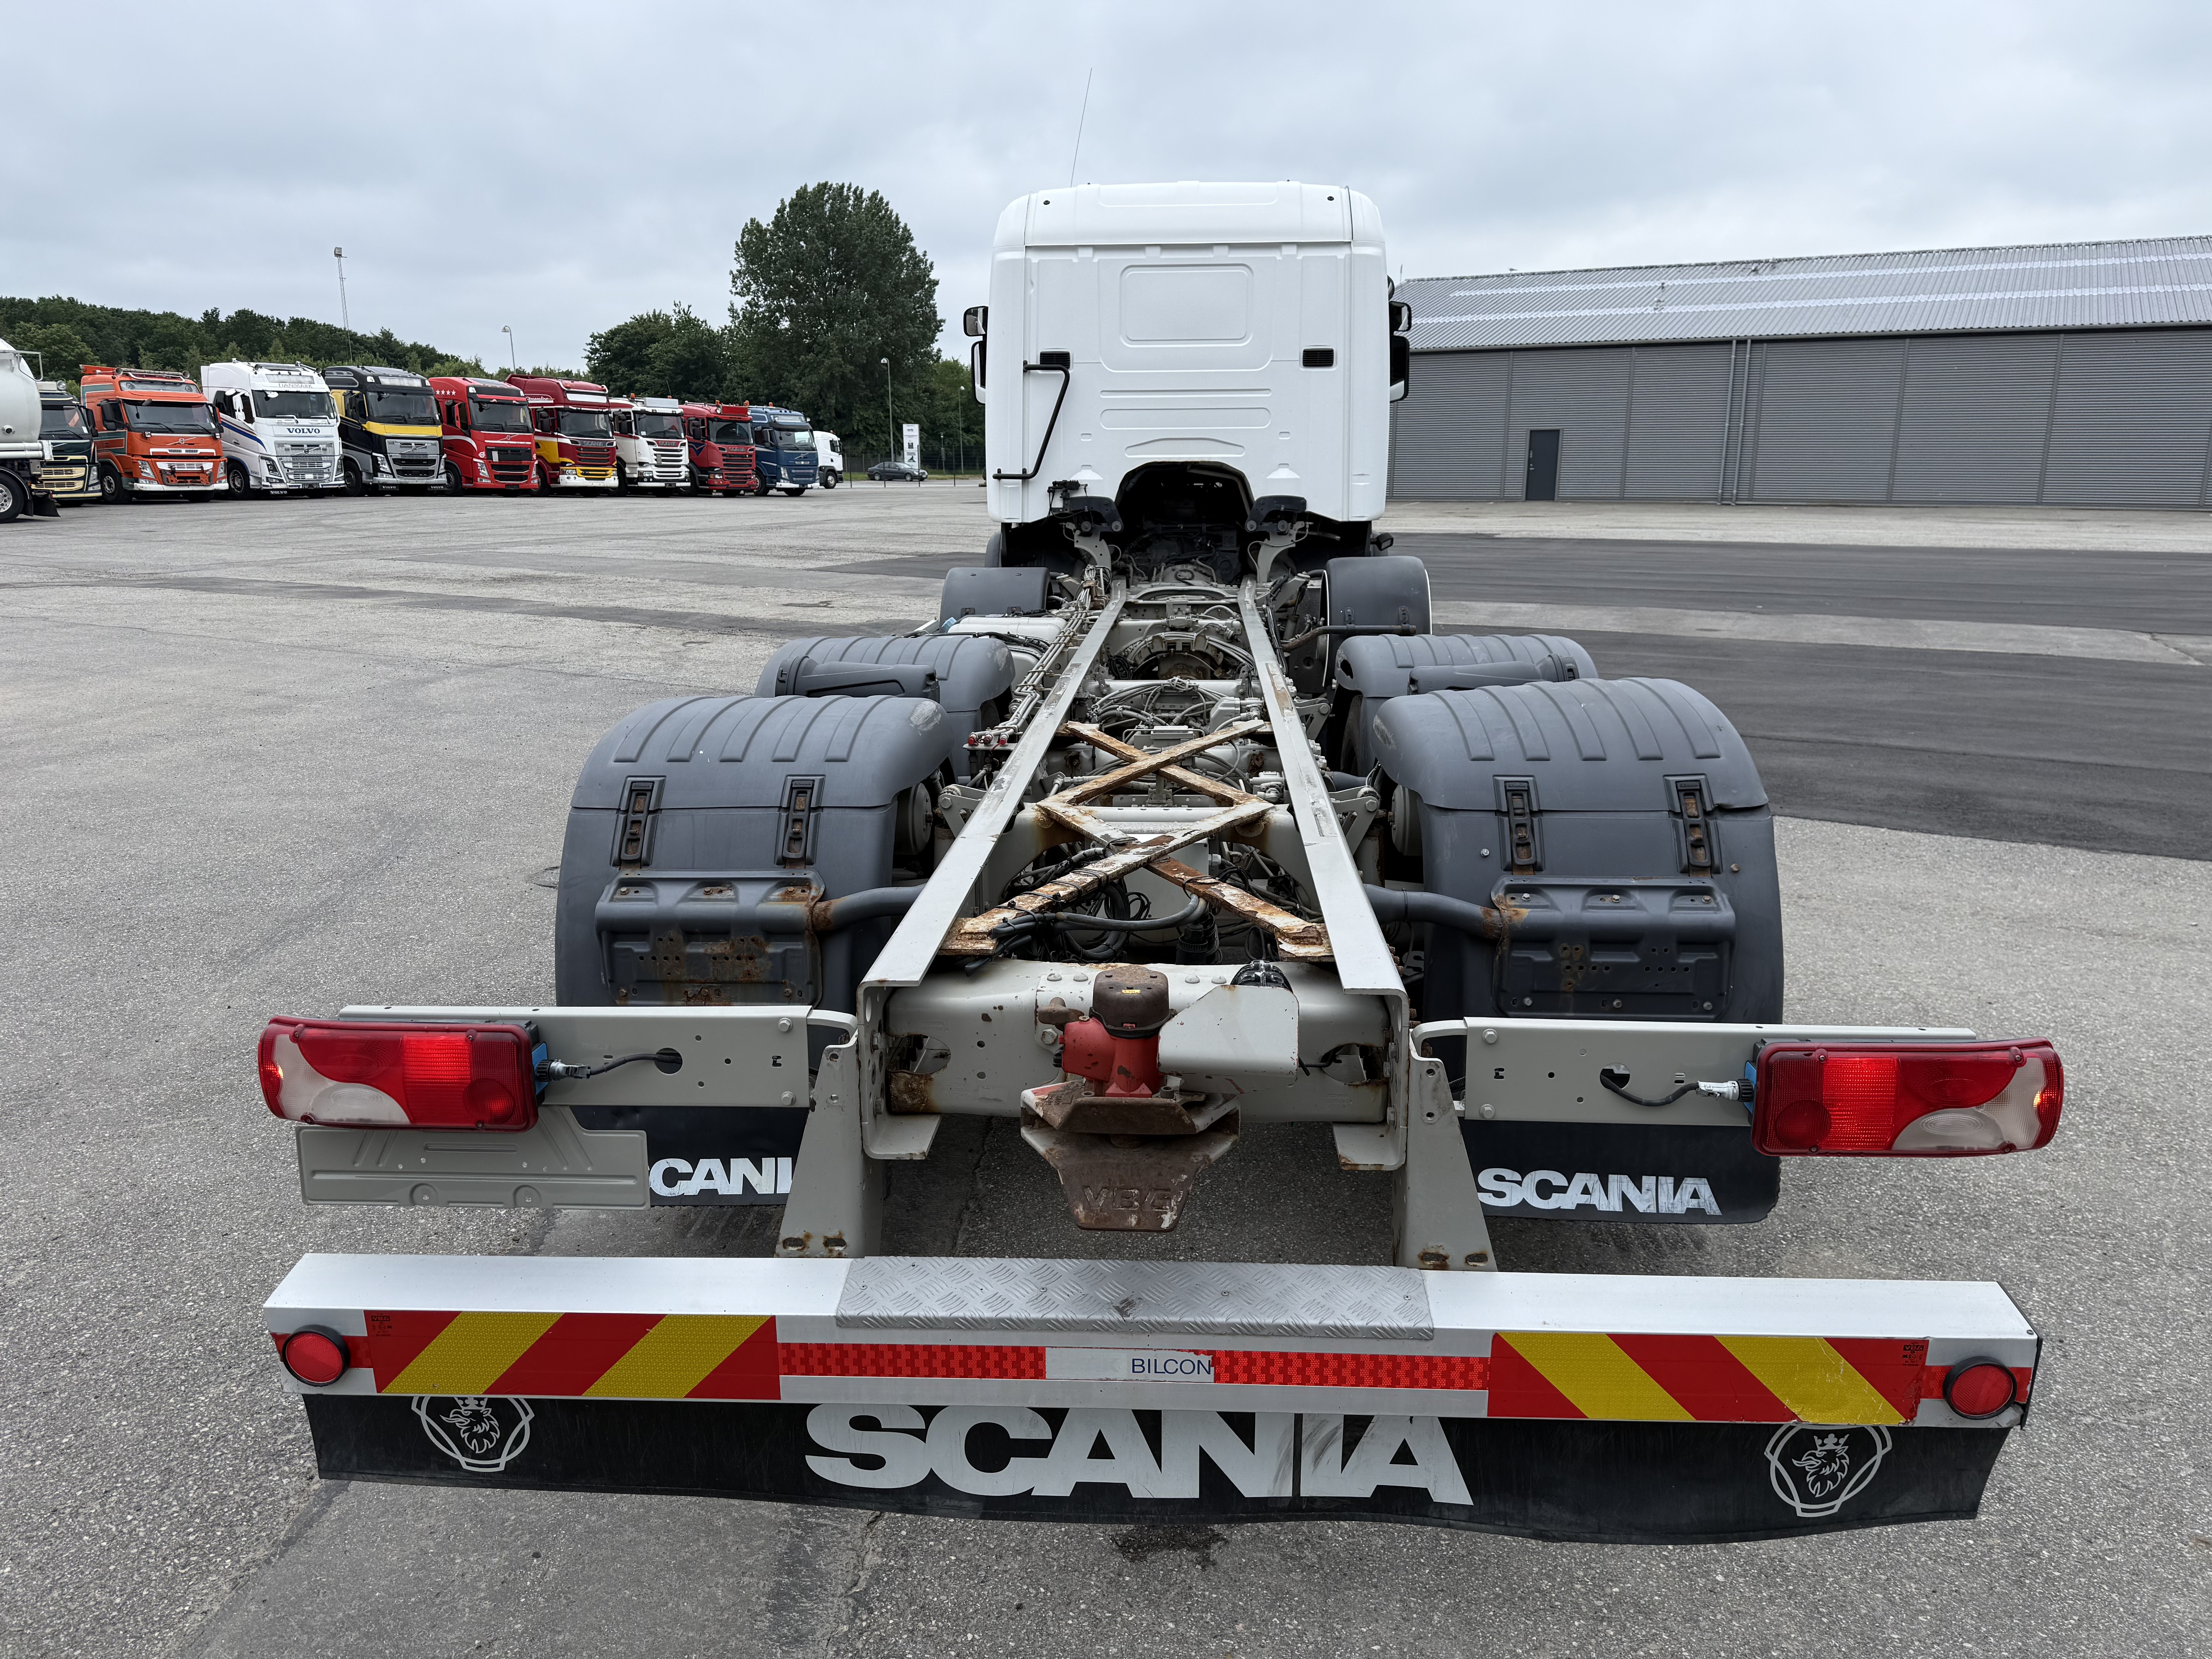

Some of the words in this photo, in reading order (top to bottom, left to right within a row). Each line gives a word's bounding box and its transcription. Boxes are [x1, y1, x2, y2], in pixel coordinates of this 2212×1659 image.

[648, 1157, 792, 1197] CANI
[1478, 1168, 1722, 1215] SCANIA
[1082, 1185, 1172, 1212] VBG
[1132, 1358, 1211, 1375] BILCON
[805, 1403, 1474, 1506] SCANIA
